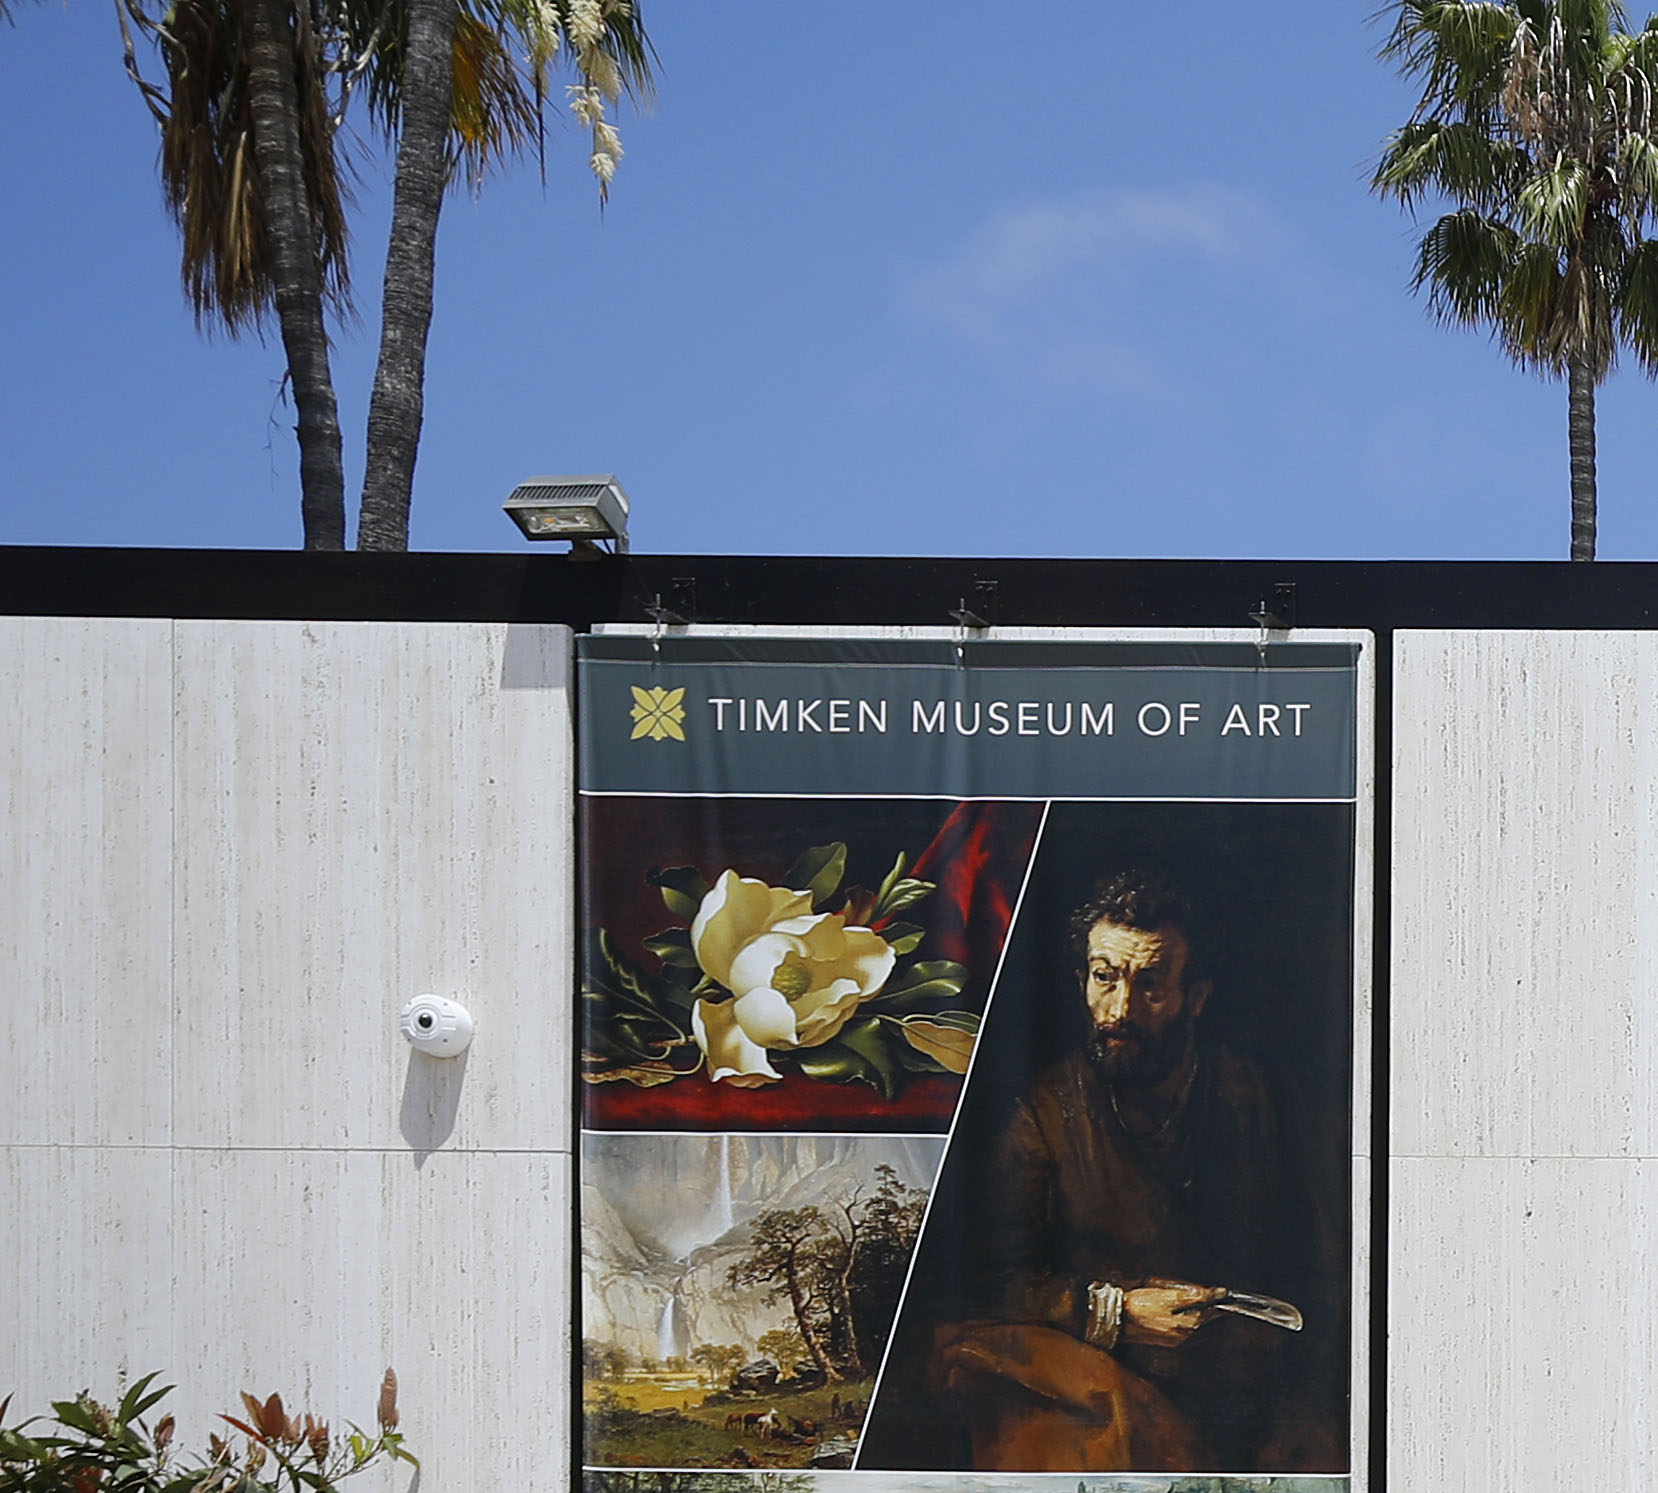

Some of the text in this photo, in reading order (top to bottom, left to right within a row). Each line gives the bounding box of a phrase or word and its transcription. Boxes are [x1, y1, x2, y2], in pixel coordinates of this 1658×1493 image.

[709, 697, 1311, 737] TIMKEN MUSEUM OF ART
